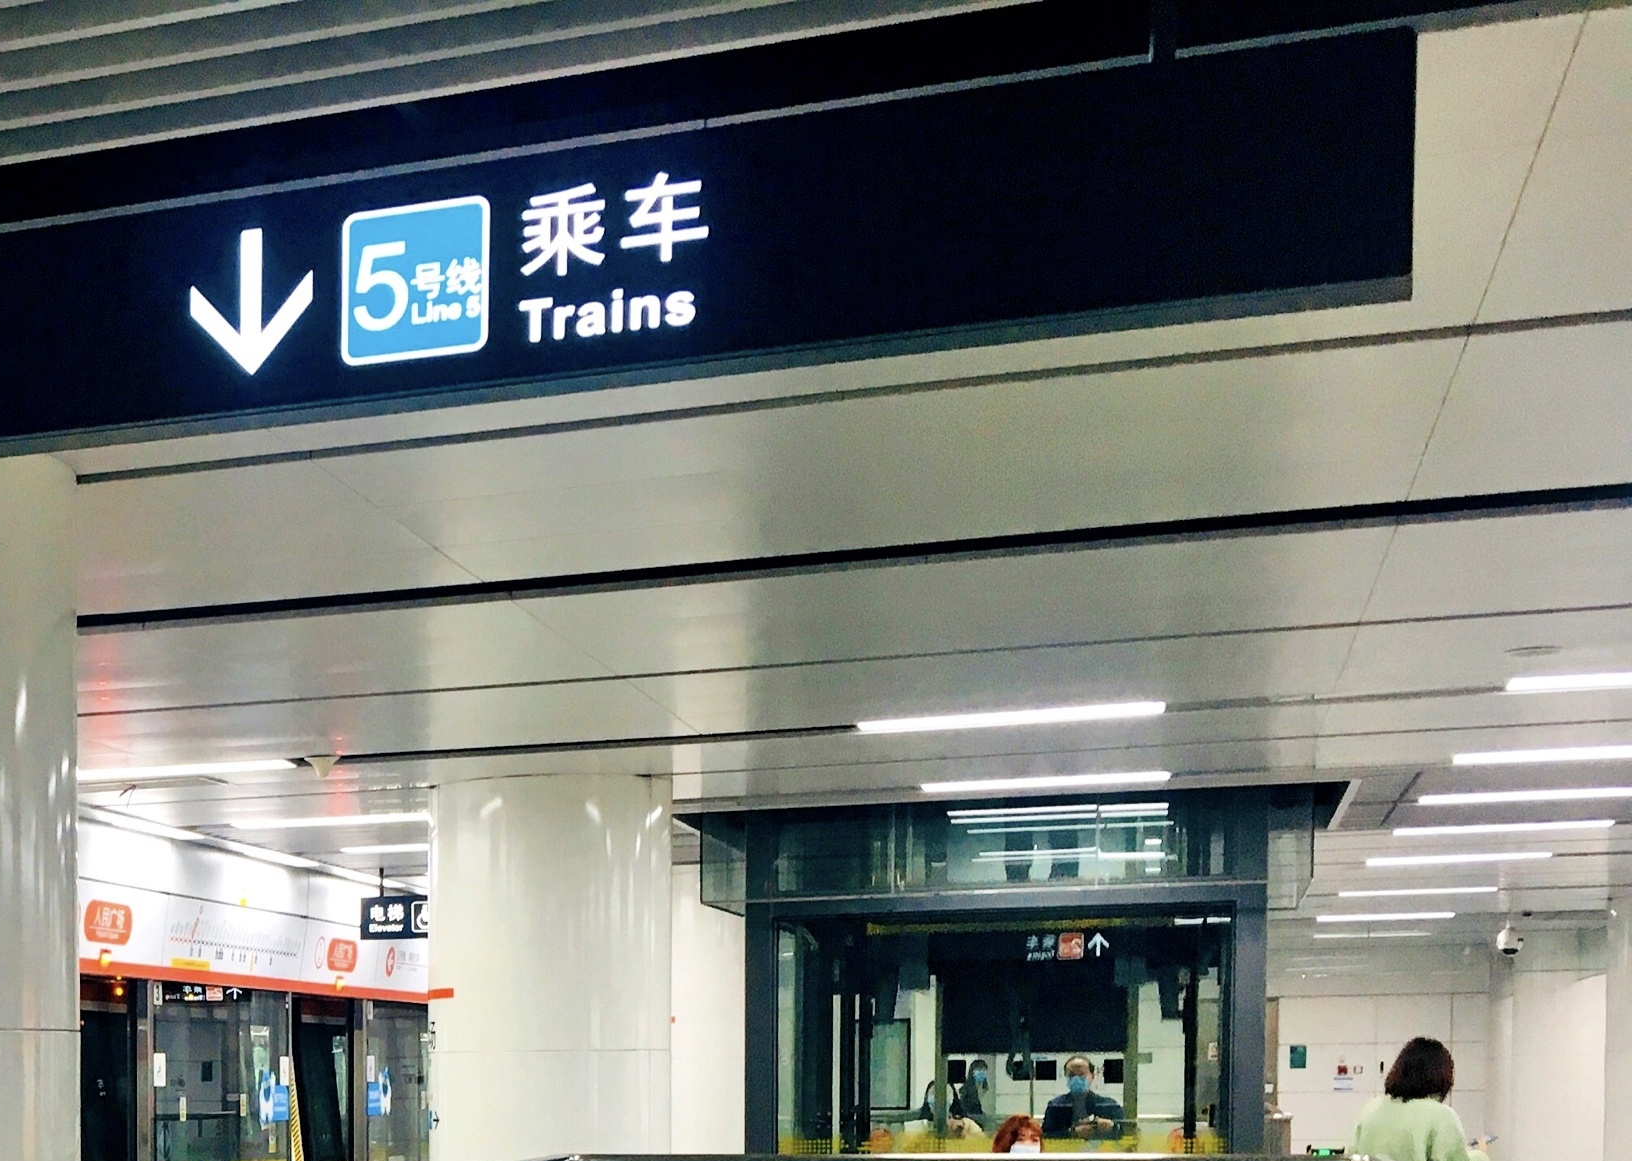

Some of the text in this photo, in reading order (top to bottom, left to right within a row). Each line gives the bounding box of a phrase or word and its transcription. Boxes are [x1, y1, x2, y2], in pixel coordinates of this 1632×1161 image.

[520, 171, 709, 276] 乘车
[411, 300, 463, 325] Line
[518, 288, 696, 343] Trains
